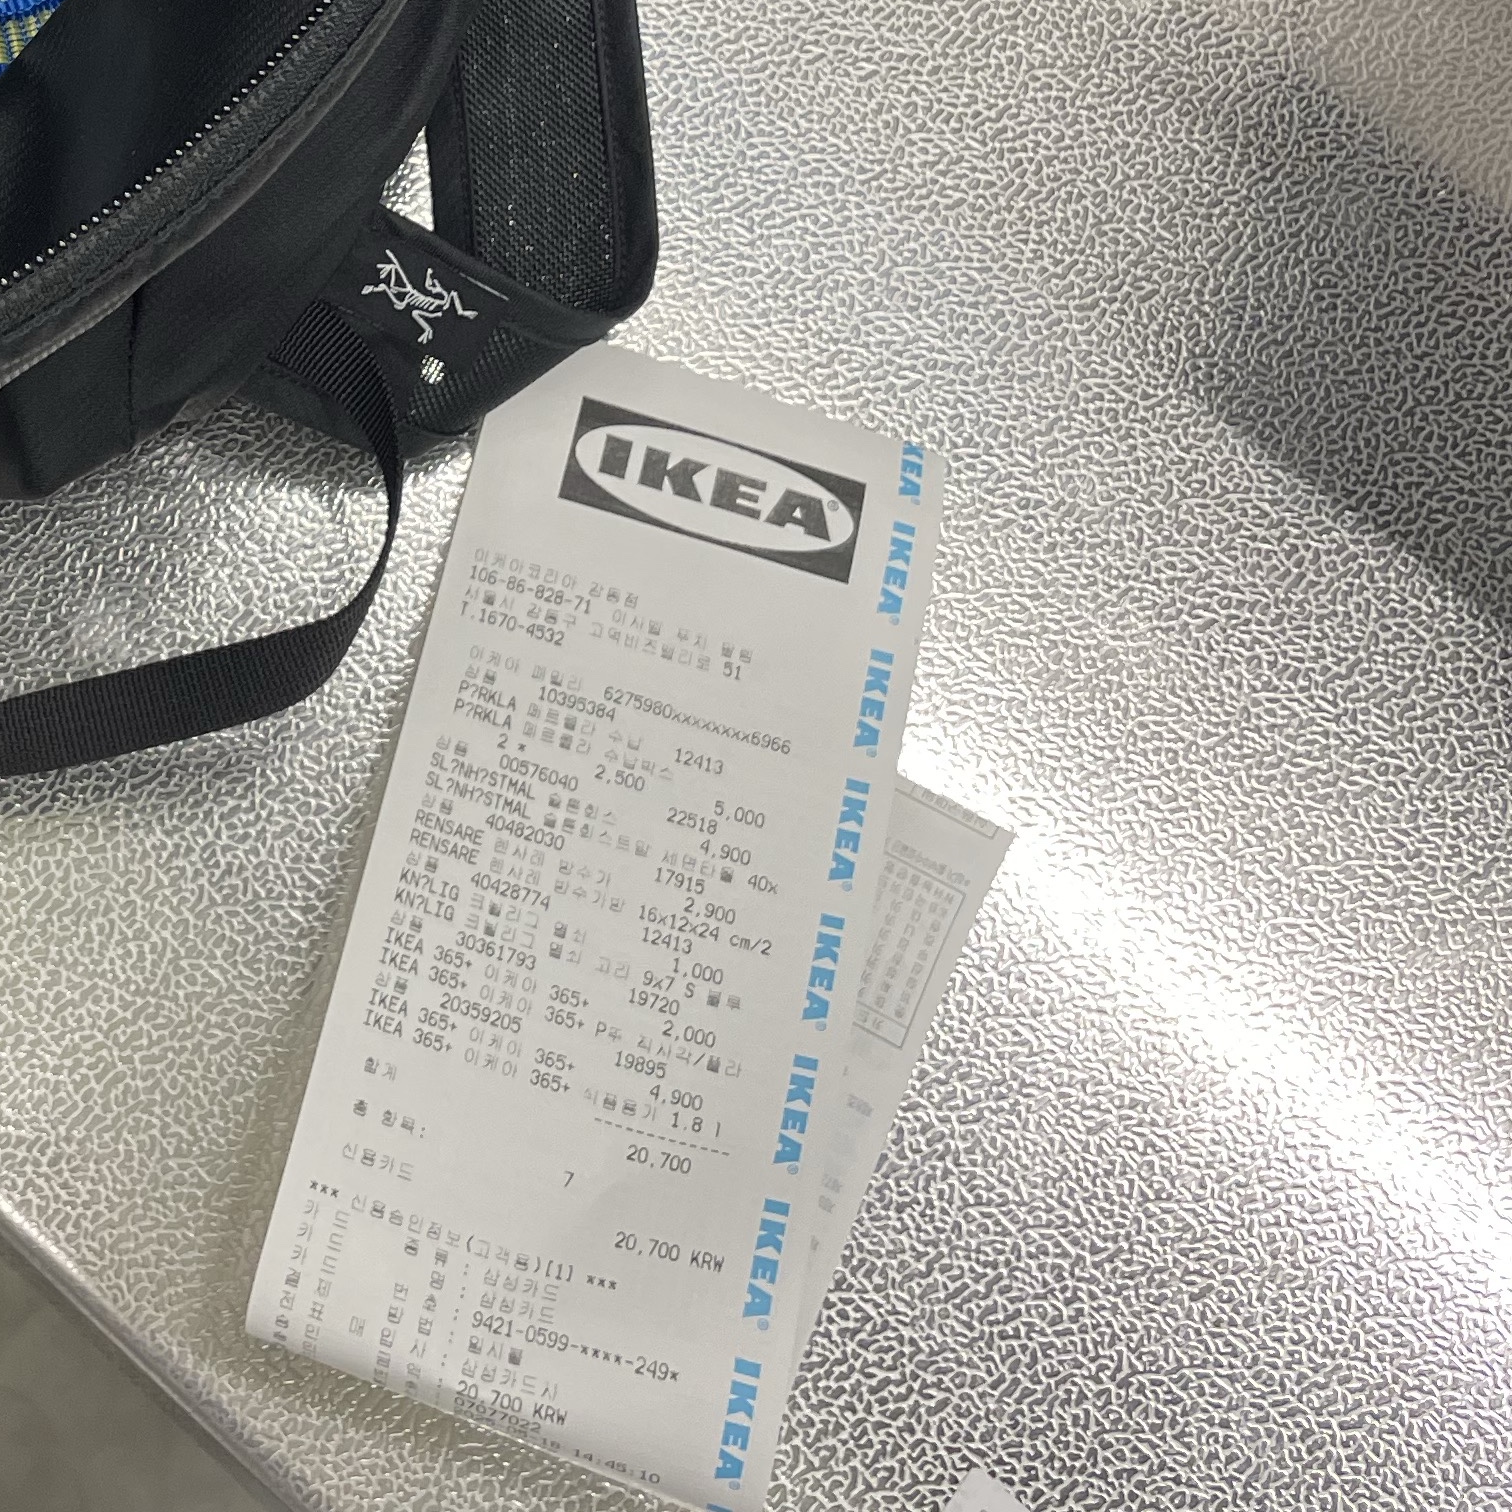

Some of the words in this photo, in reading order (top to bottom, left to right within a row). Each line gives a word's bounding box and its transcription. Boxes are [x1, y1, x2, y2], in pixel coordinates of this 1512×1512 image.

[597, 434, 833, 542] IKEA
[898, 441, 926, 497] KEA
[469, 564, 591, 615] 106-86-828-71
[879, 521, 916, 614] IKEA
[460, 599, 565, 646] T.1670-4532
[453, 697, 511, 730] P?RKLA
[537, 685, 616, 722] 10395384
[722, 660, 741, 681] 51
[854, 649, 894, 747] IKEA
[457, 678, 516, 712] P?RKLA
[674, 747, 724, 775] 12413
[603, 685, 791, 755] 6275980xxxxxxxx6966
[424, 770, 531, 820] SL?NH?STMAL
[747, 873, 778, 895] 40x
[429, 751, 535, 800] SL?NH?STMAL
[699, 838, 751, 866] 4,900
[498, 753, 579, 792] 00576040
[665, 806, 718, 835] 22518
[593, 763, 645, 792] 2,500
[713, 799, 765, 829] 5,000
[829, 778, 870, 881] IKEA
[409, 827, 480, 865] RENSARE
[638, 904, 720, 942] 16x12x24
[728, 934, 772, 956] cm/2
[414, 808, 485, 846] RENSARE
[682, 896, 736, 925] 2,900
[484, 813, 565, 851] 40482030
[654, 866, 705, 895] 17915
[393, 886, 455, 922] KN?LIG
[642, 969, 675, 991] 9x7
[398, 866, 460, 902] KN?LIG
[672, 956, 724, 985] 1,000
[470, 871, 551, 912] 40428774
[641, 926, 693, 955] 12413
[378, 945, 418, 976] IKEA
[427, 965, 467, 989] 365+
[543, 1004, 584, 1029] 365+
[384, 925, 423, 955] IKEA
[432, 944, 472, 969] 365+
[548, 983, 589, 1008] 365+
[661, 1019, 716, 1049] 2,000
[455, 930, 536, 971] 30361793
[628, 987, 680, 1016] 19720
[802, 913, 846, 1020] IKEA
[362, 1008, 402, 1038] IKEA
[412, 1027, 452, 1052] 365+
[529, 1068, 570, 1092] 365+
[670, 1110, 703, 1133] 1.8
[367, 987, 408, 1017] IKEA
[417, 1006, 457, 1031] 365+
[533, 1047, 575, 1071] 365+
[648, 1083, 703, 1111] 4,900
[439, 991, 523, 1034] 20359205
[614, 1049, 667, 1079] 19895
[773, 1054, 819, 1164] IKEA
[625, 1143, 692, 1174] 20,700
[613, 1230, 680, 1262] 20,700
[689, 1249, 724, 1273] KRW
[744, 1198, 791, 1317] IKEA
[451, 1379, 523, 1414] 20,700
[531, 1402, 567, 1426] KRW
[714, 1357, 762, 1481] IKEA
[573, 1448, 660, 1484] 14:45:10
